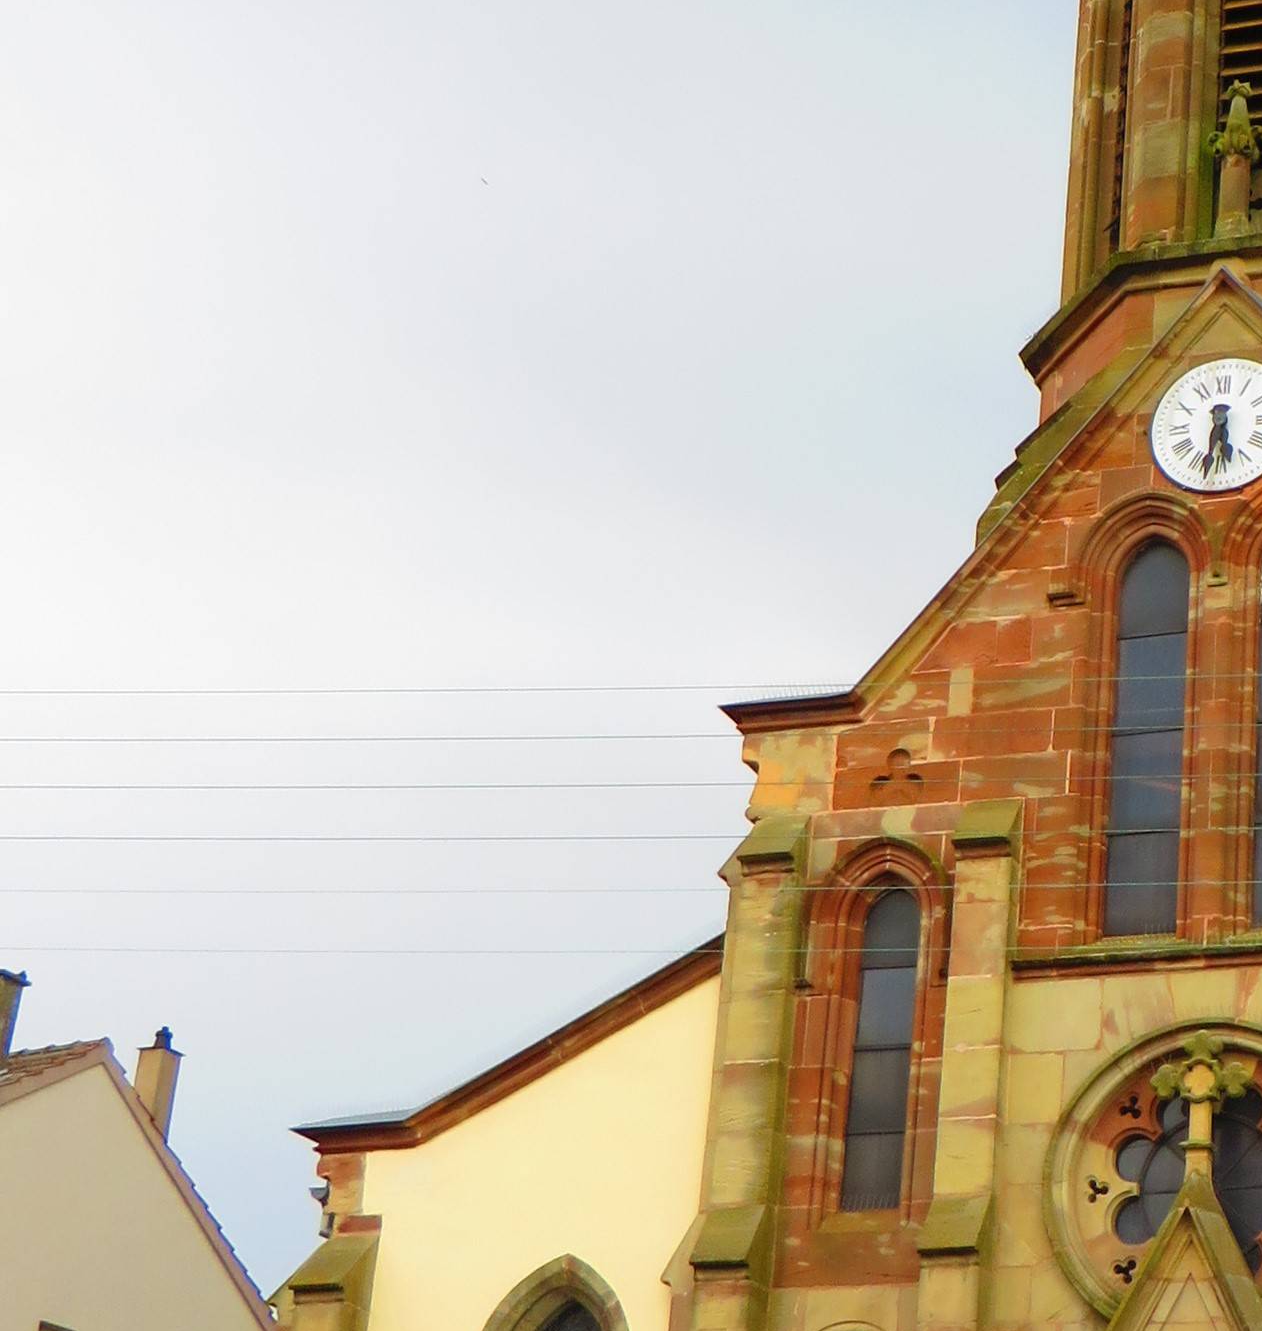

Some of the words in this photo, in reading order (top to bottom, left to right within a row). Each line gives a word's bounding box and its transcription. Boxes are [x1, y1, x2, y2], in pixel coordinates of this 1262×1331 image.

[1192, 382, 1211, 403] XI
[1216, 375, 1231, 395] XII
[1239, 377, 1252, 397] I
[1175, 401, 1197, 416] X
[1169, 422, 1191, 436] IX
[1172, 437, 1195, 461] VIII
[1238, 448, 1253, 468] V
